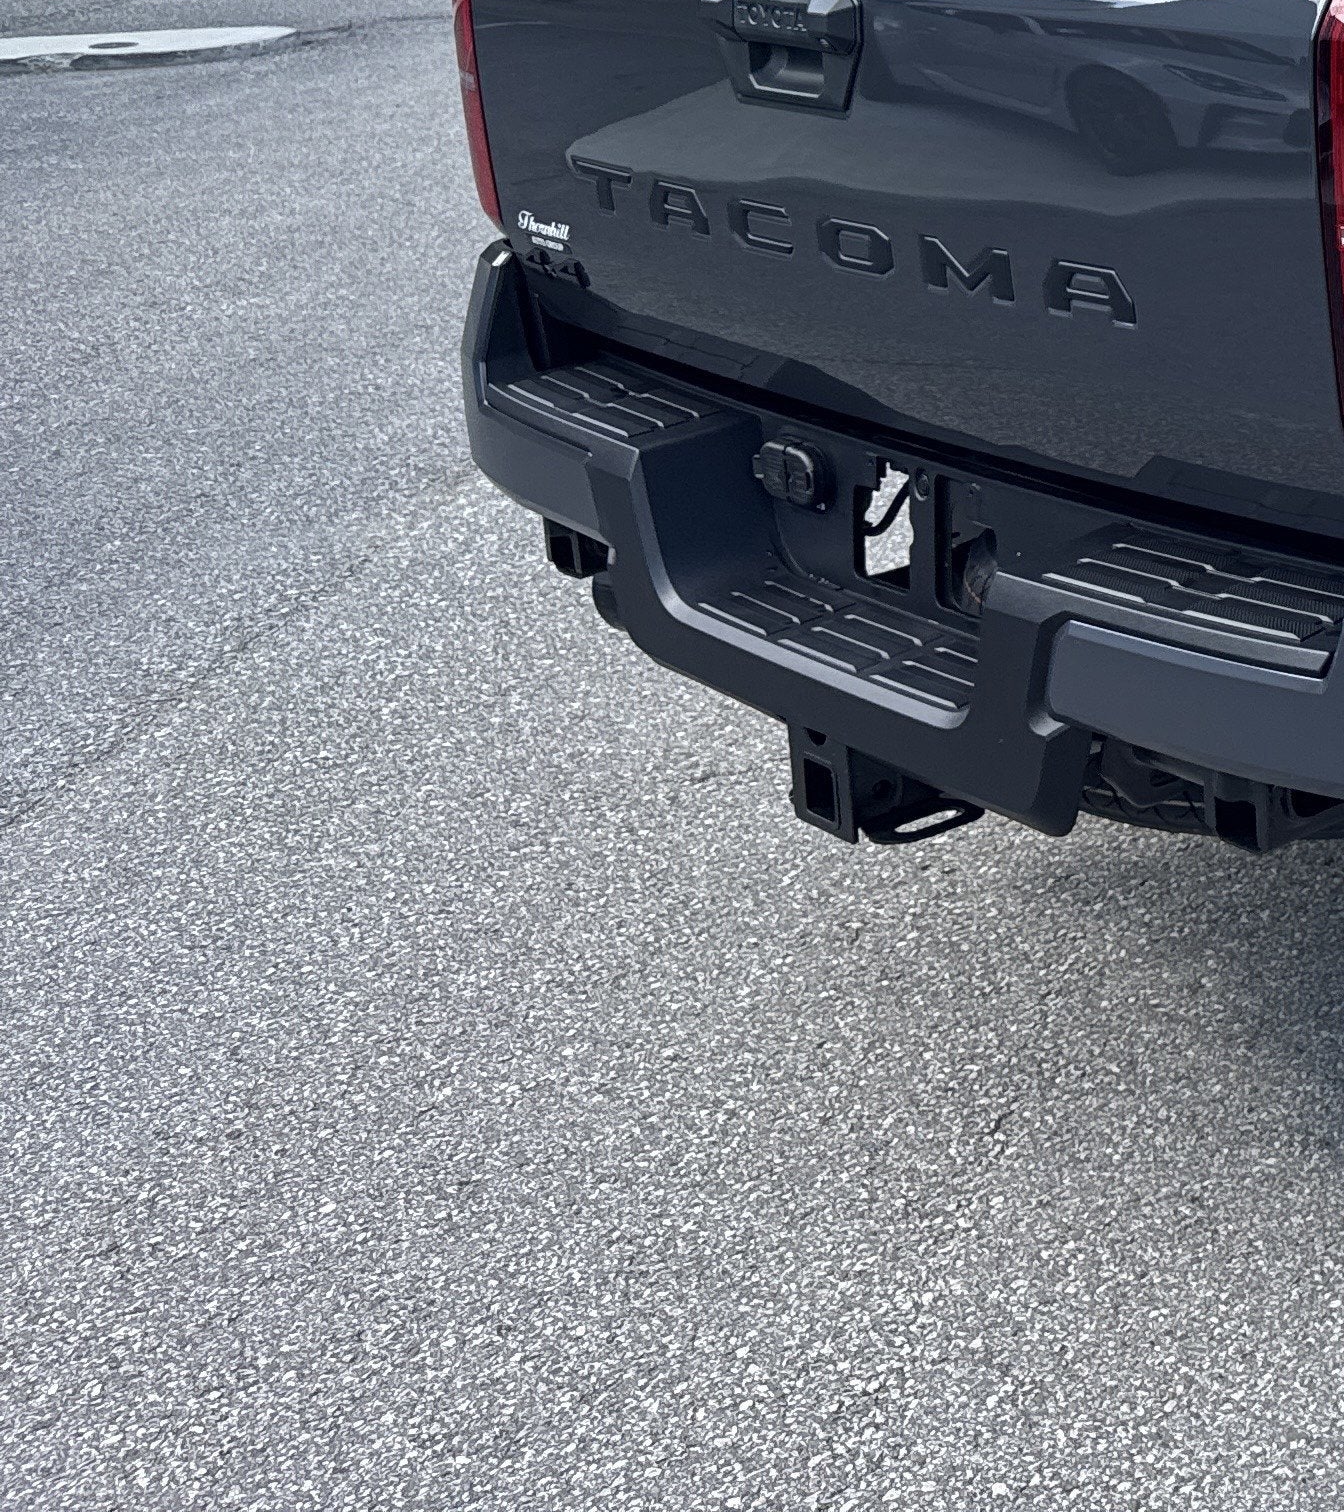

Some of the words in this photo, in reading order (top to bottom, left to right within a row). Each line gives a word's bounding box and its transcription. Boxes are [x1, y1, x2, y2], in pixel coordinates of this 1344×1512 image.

[735, 2, 808, 32] TOYOTA
[518, 210, 570, 241] Thornhill
[571, 155, 1138, 329] TACOMA
